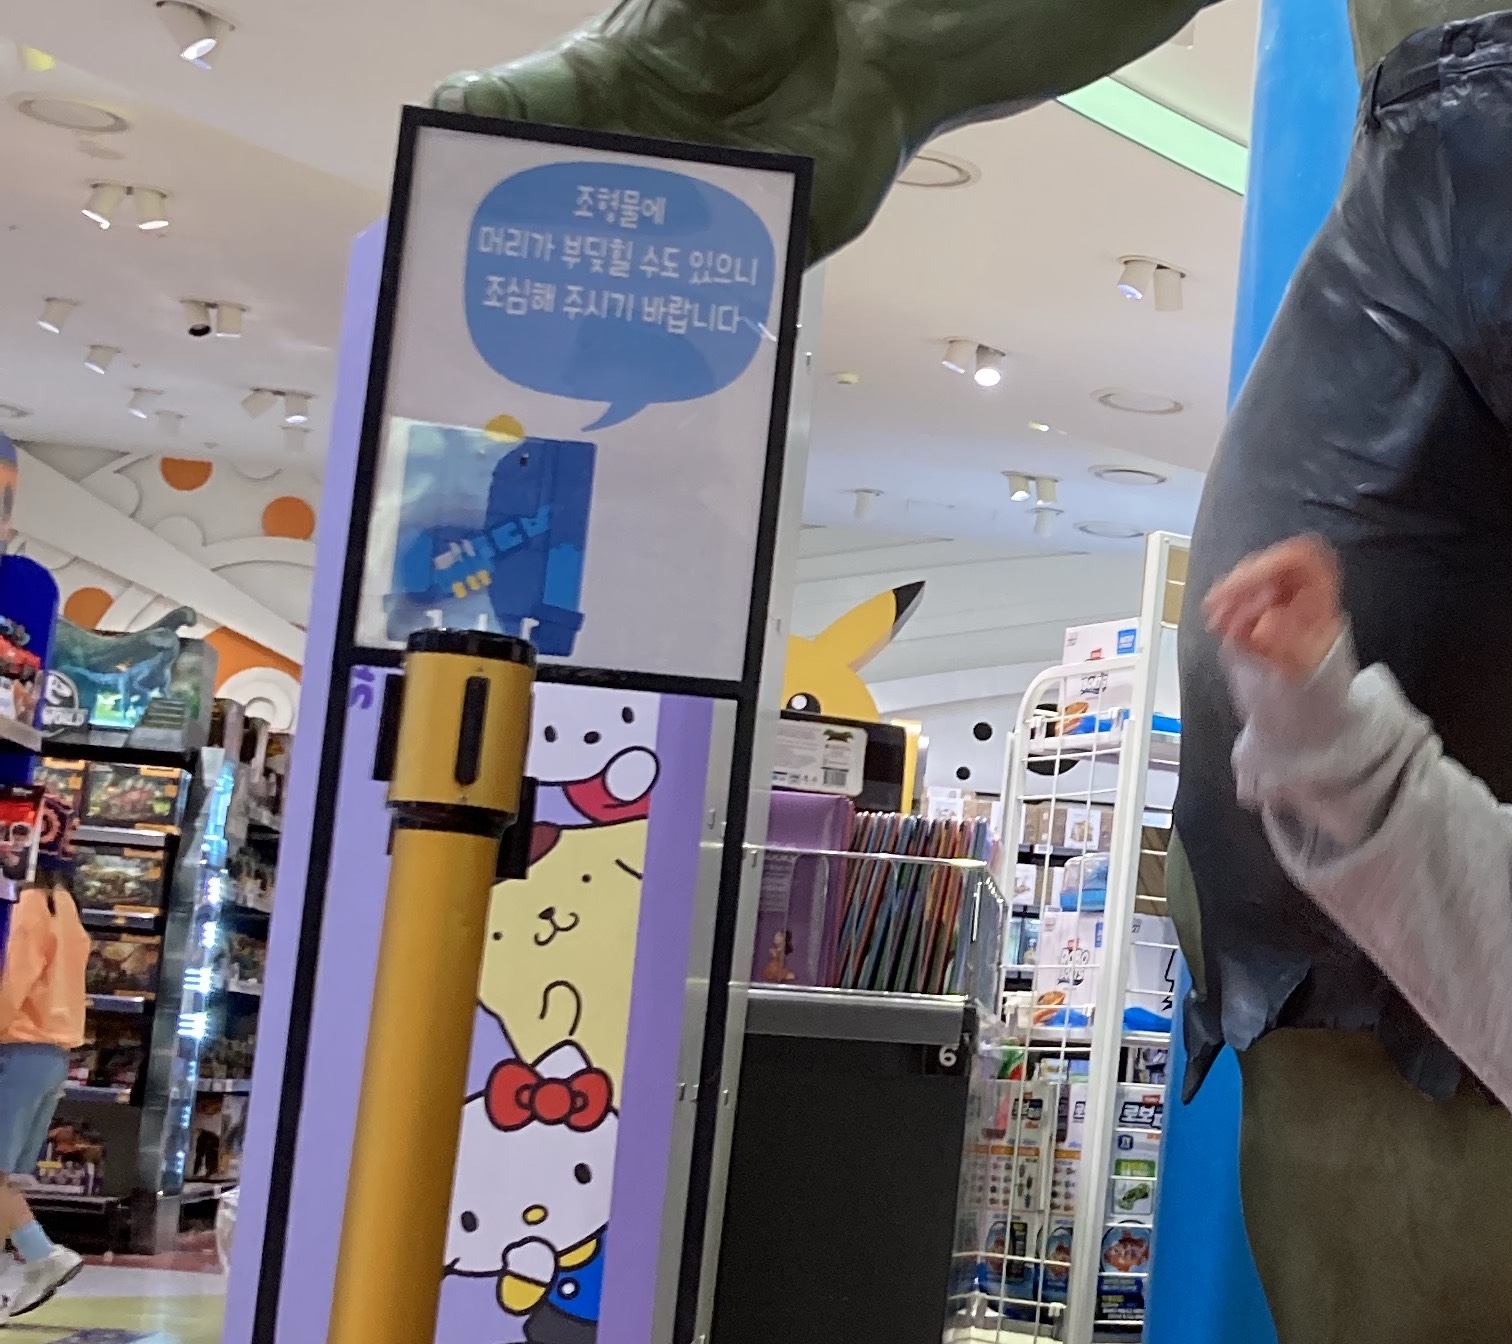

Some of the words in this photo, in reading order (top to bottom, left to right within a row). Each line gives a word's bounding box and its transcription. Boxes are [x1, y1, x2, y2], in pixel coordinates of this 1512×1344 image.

[573, 185, 666, 229] 조형물에
[478, 226, 555, 261] 머리가
[561, 234, 634, 278] 부딪힐
[639, 245, 681, 279] 수도
[688, 250, 758, 286] 있으니
[482, 274, 556, 316] 조심해
[562, 284, 635, 322] 주시기
[641, 294, 740, 334] 바랍니다
